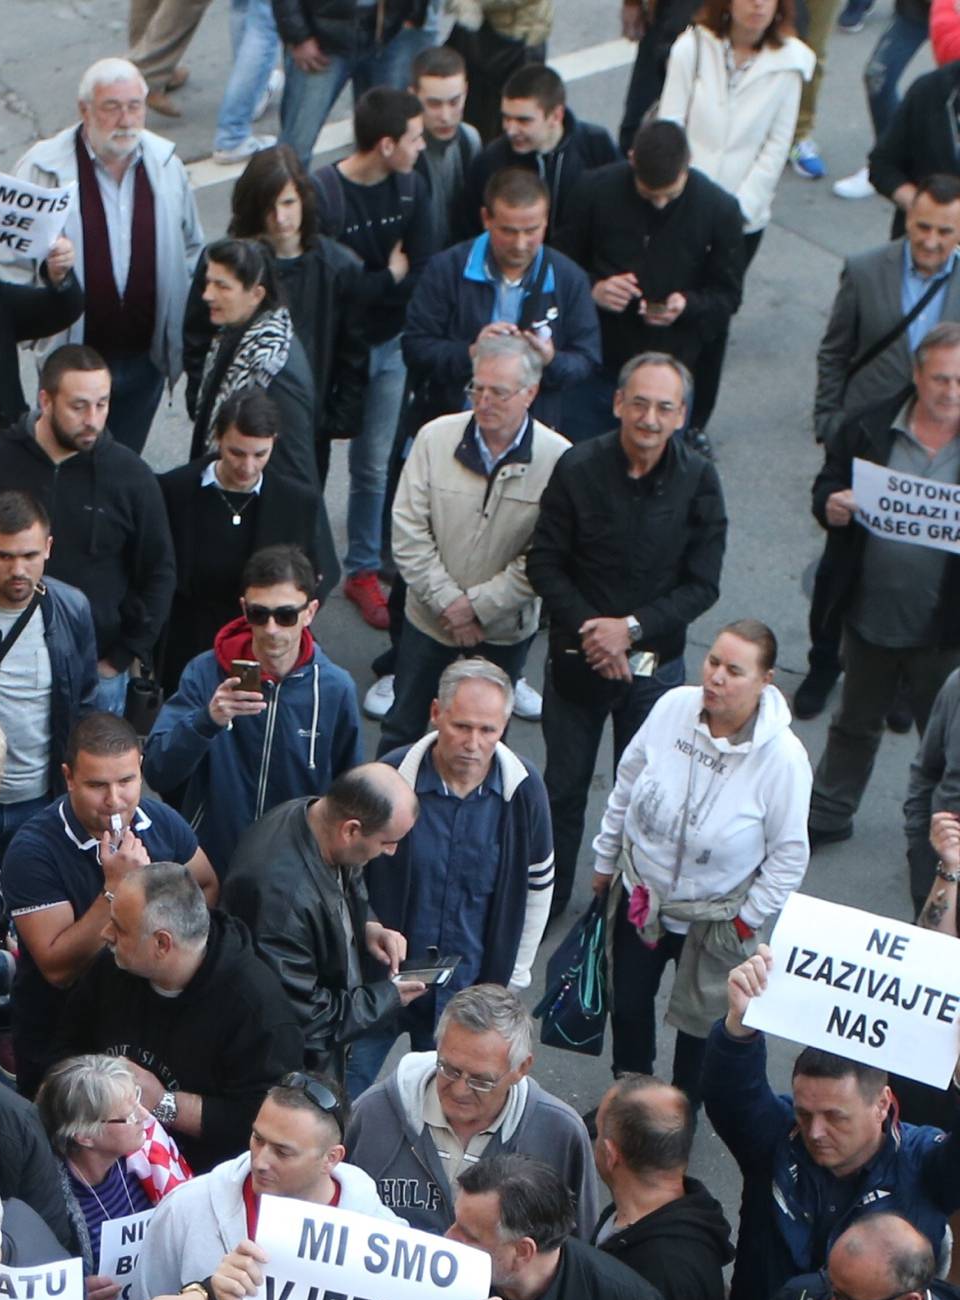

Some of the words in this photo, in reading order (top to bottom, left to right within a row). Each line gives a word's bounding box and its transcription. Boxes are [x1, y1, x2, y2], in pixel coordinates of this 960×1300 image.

[878, 497, 948, 520] ODLAZI
[866, 928, 910, 961] NE
[785, 946, 960, 1024] IZAZIVAJTE
[826, 1005, 889, 1048] NAS
[121, 1217, 151, 1246] NI
[116, 1253, 139, 1276] B
[297, 1217, 349, 1267] MI
[363, 1232, 459, 1288] SMO
